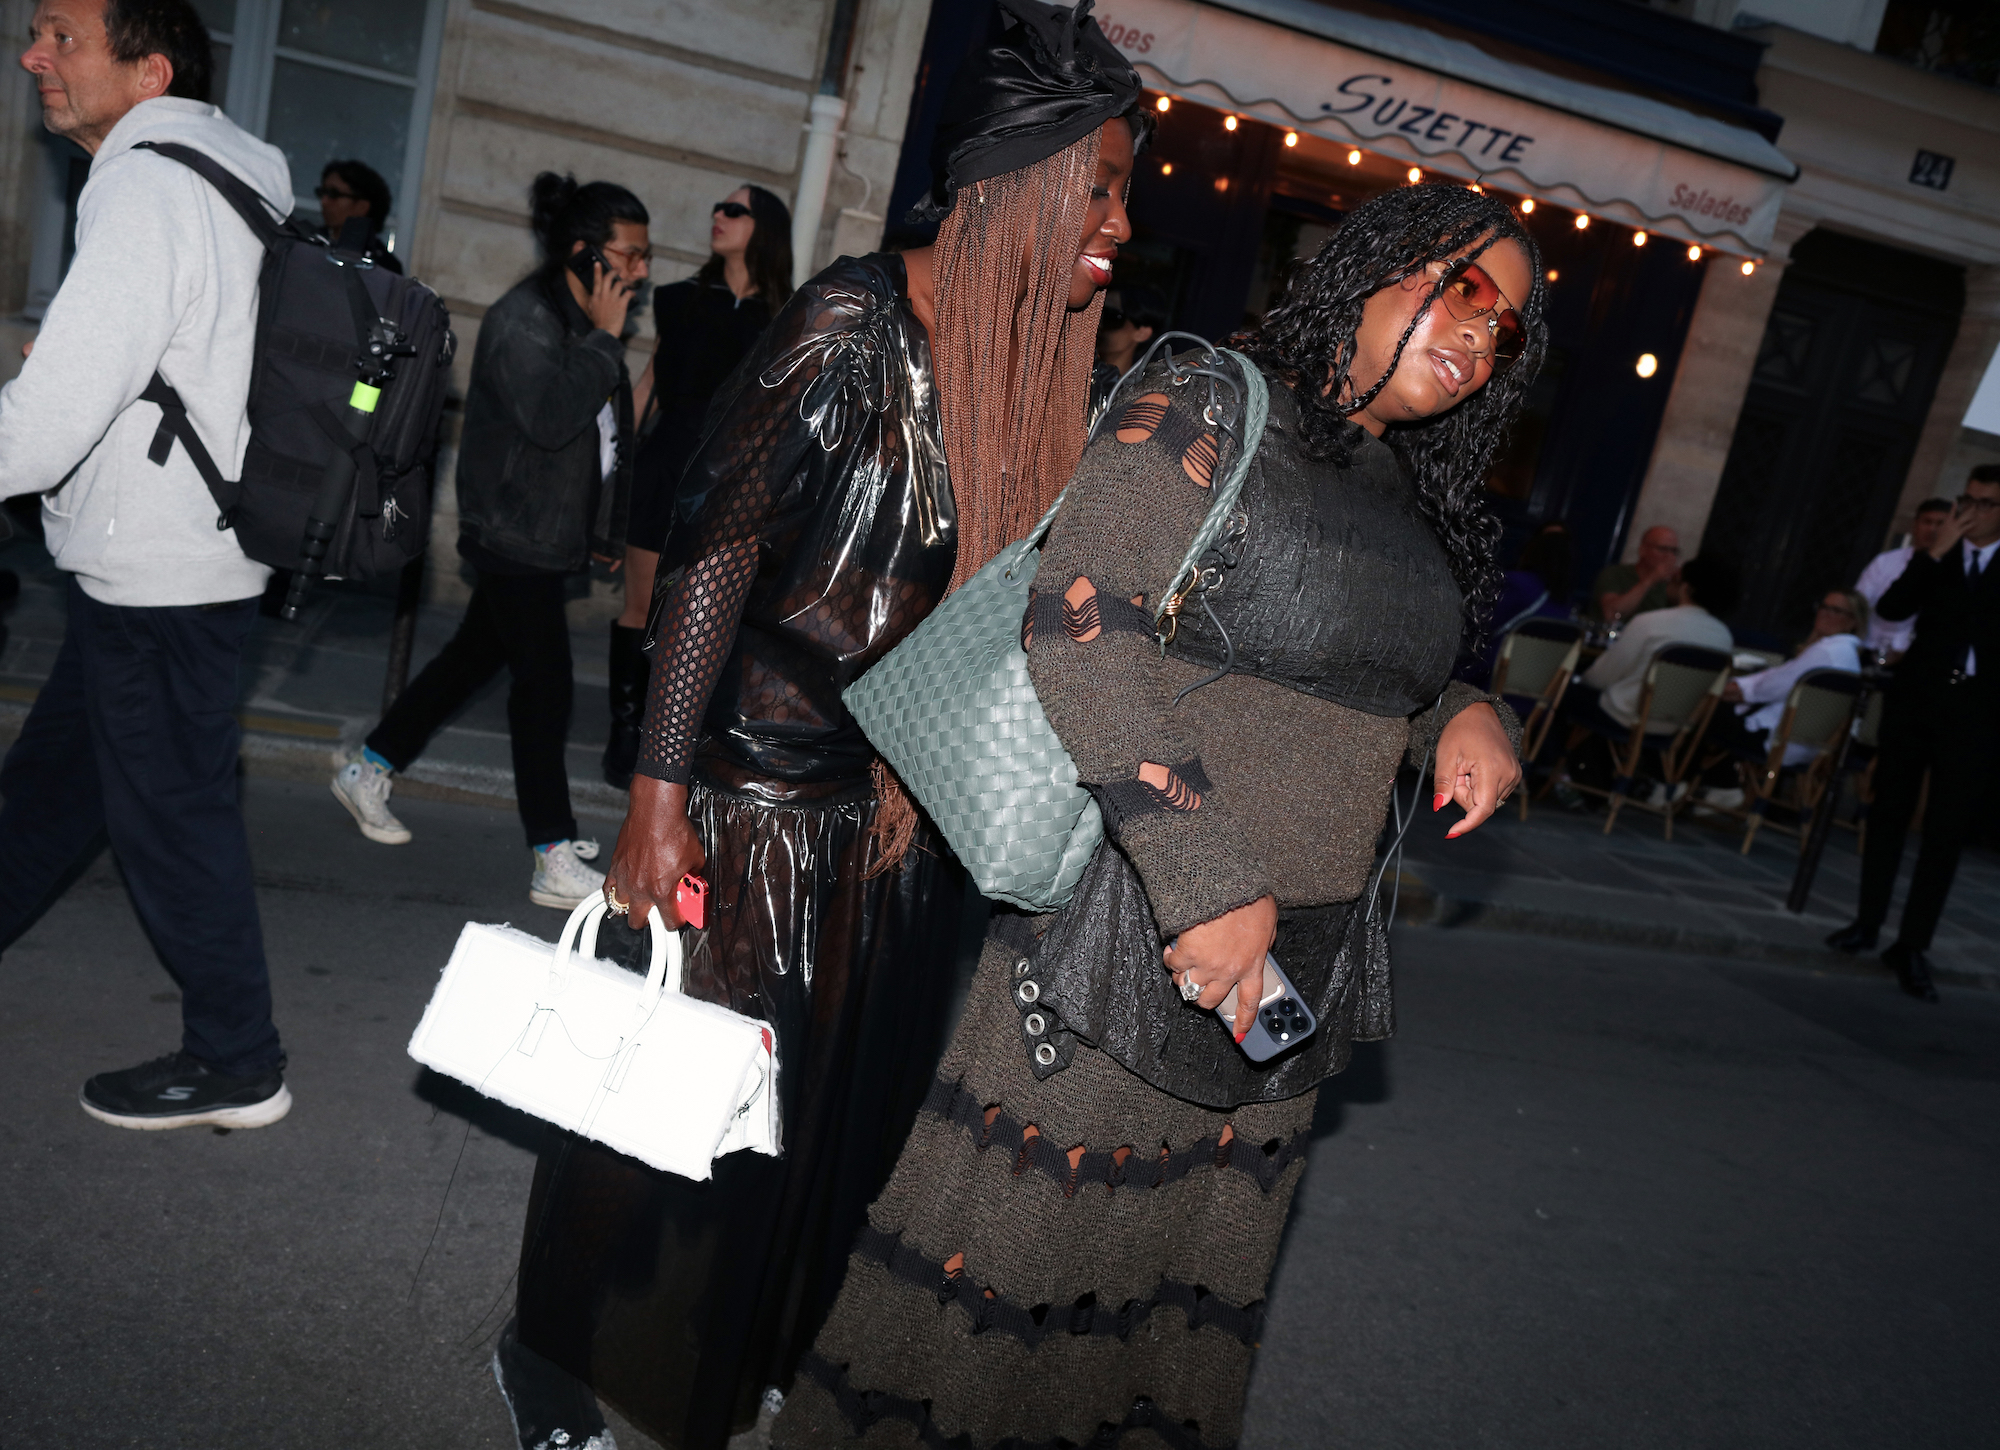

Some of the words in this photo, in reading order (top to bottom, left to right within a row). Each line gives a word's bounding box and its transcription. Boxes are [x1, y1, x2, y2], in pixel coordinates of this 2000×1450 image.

[1319, 74, 1535, 163] SUZETTE
[1914, 153, 1948, 187] 24
[1668, 183, 1752, 226] Salades
